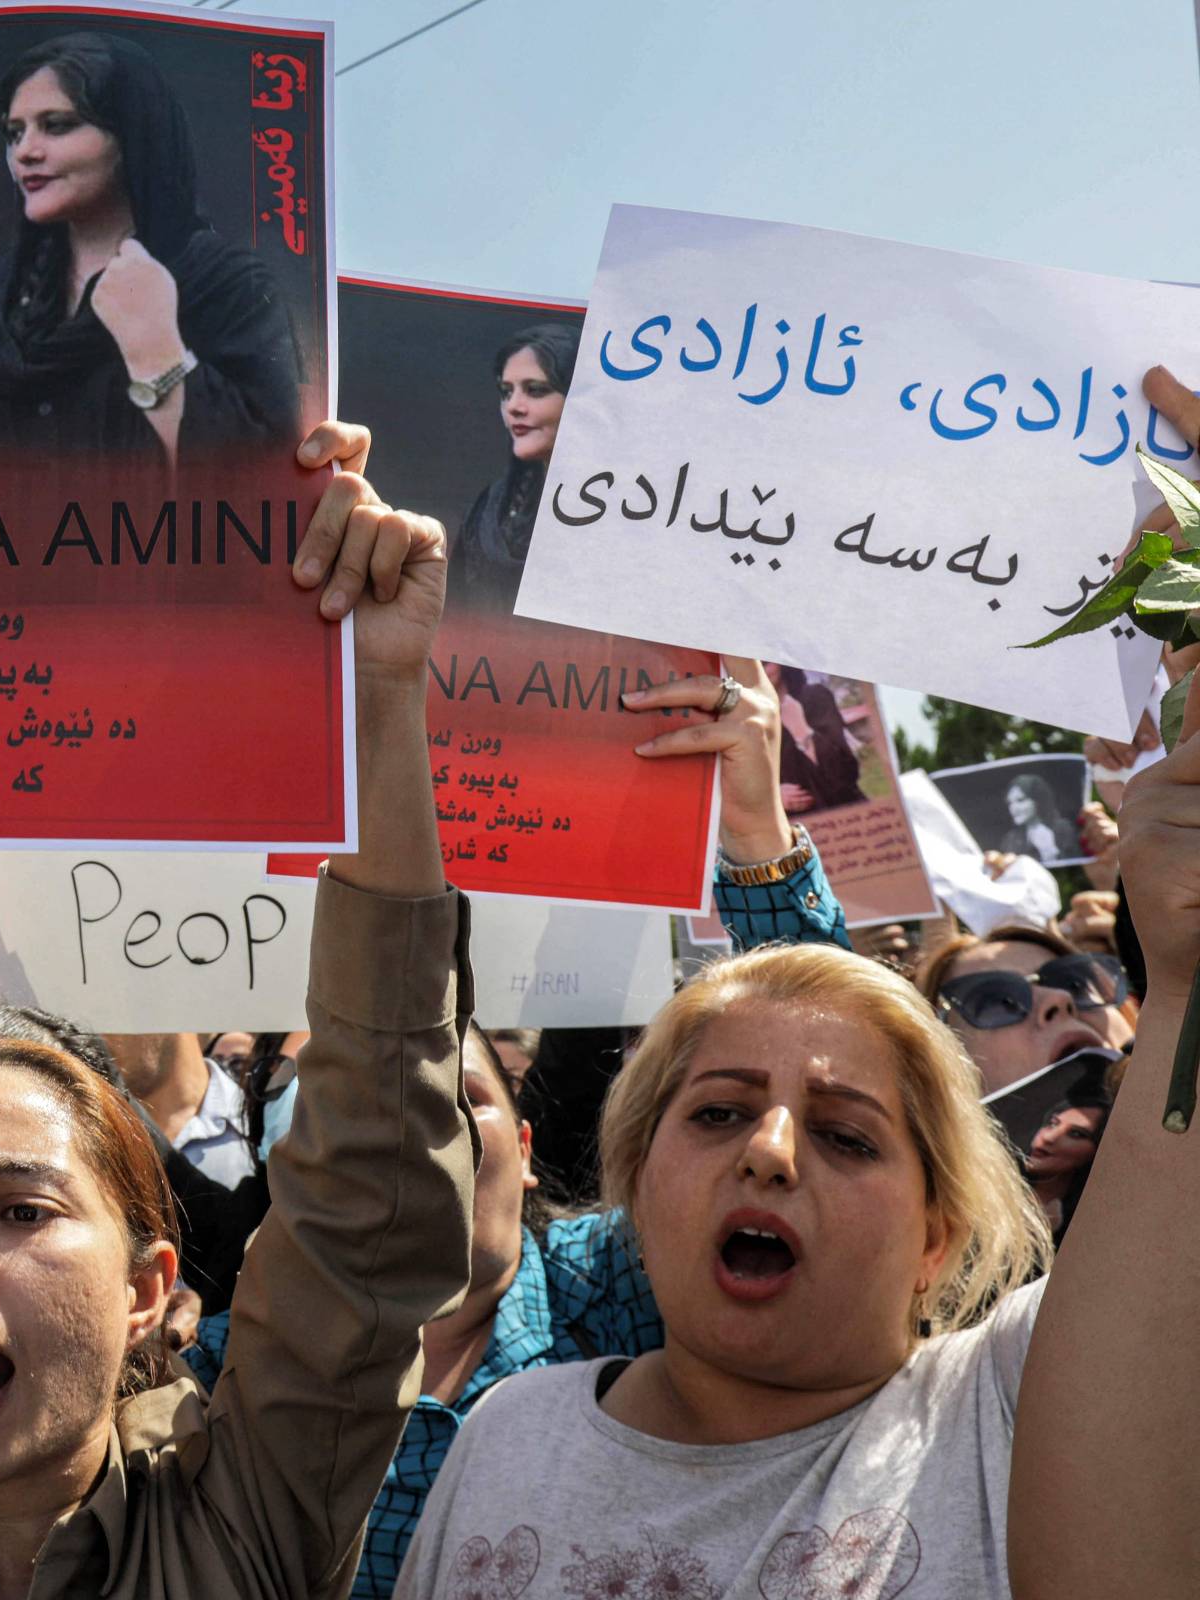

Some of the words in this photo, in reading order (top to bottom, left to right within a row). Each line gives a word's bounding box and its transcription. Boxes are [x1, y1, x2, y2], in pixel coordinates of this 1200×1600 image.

[251, 51, 307, 110] ژینا
[599, 303, 864, 406] ئازادی
[43, 500, 296, 566] AMINI
[552, 463, 795, 572] بێدادی
[7, 707, 94, 747] ئێوەش
[109, 717, 137, 739] دە
[460, 732, 503, 756] وەرن
[12, 764, 45, 793] کە
[552, 816, 572, 832] دە
[487, 843, 510, 863] کە
[72, 859, 287, 990] Peop
